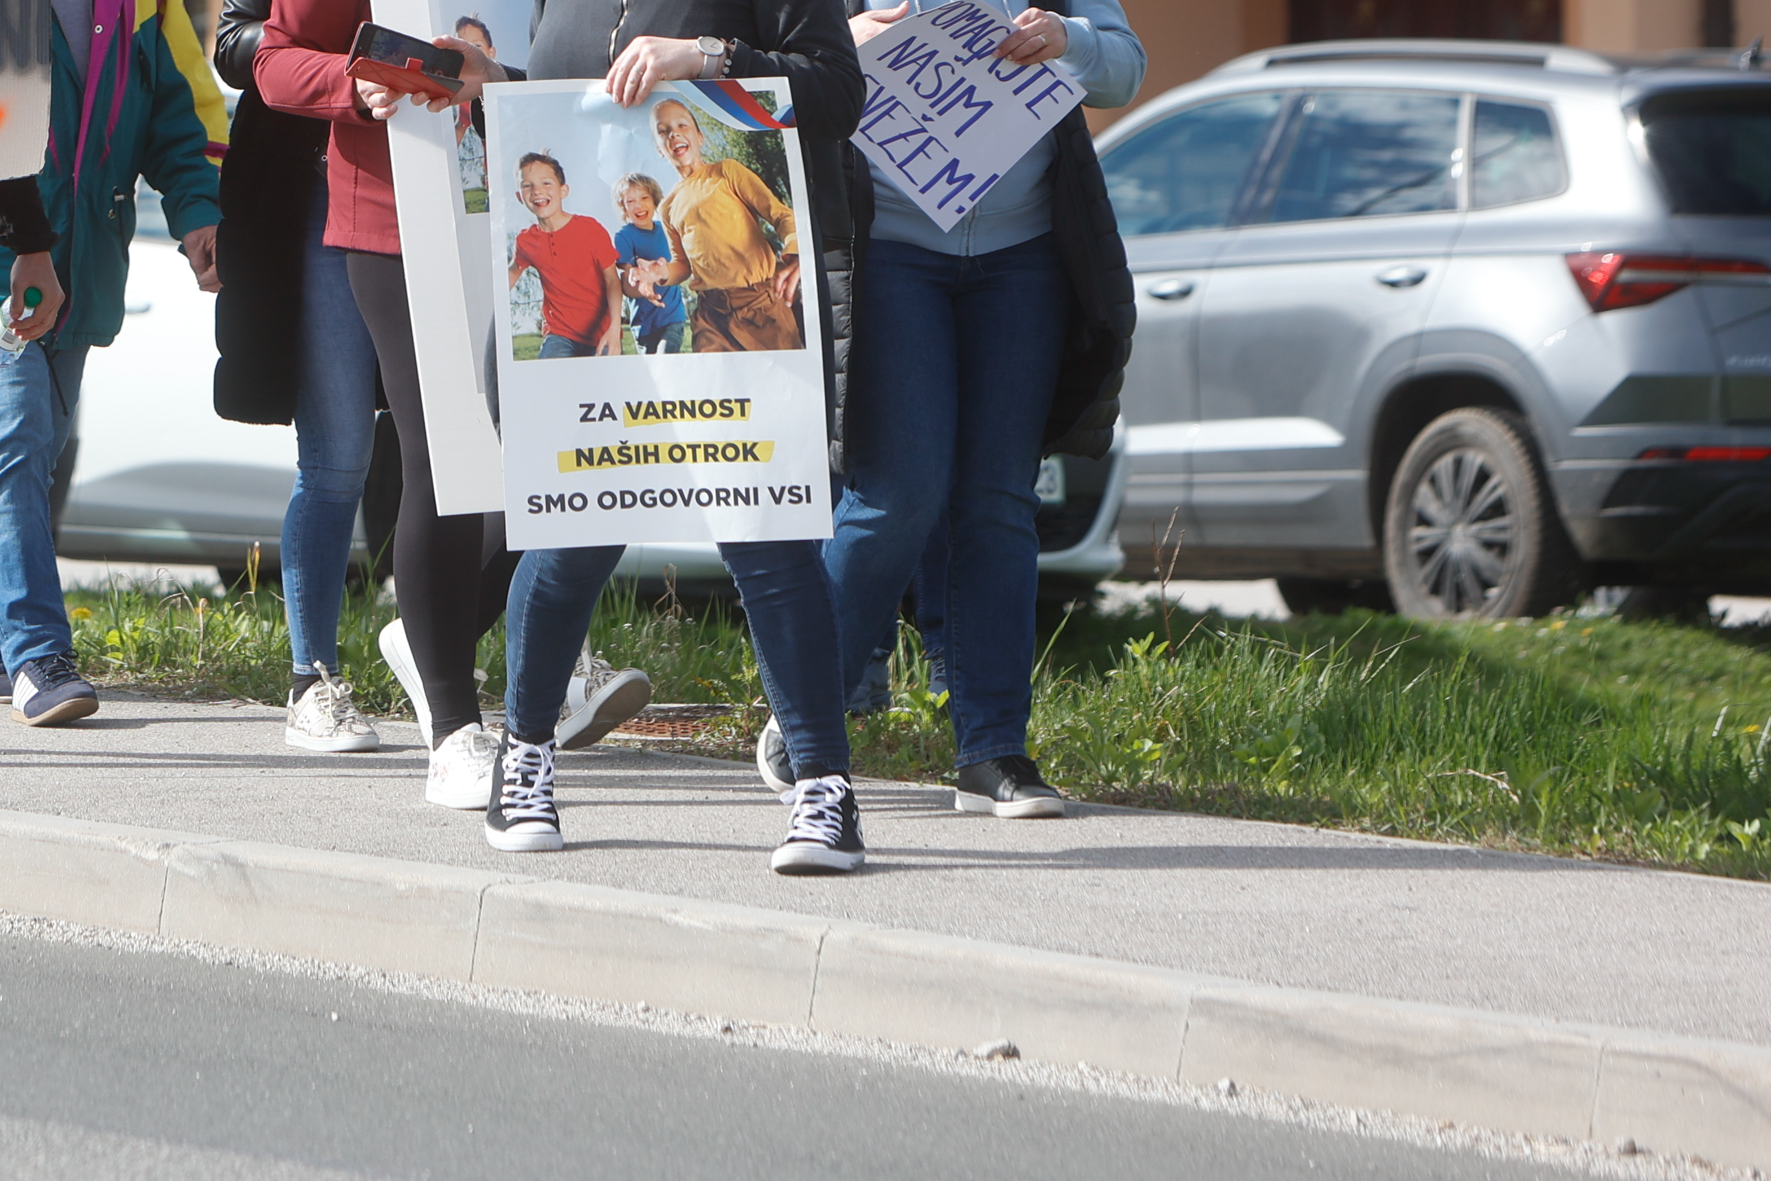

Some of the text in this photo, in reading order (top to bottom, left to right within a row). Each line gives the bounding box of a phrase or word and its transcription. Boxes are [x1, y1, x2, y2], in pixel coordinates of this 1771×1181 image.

[876, 35, 995, 138] NAŠIM
[858, 73, 1000, 214] VEŽEM!
[579, 398, 751, 423] ZA VARNOST
[575, 440, 760, 468] NAŠIH OTROK
[527, 484, 812, 515] SMO ODGOVORNI VSI
